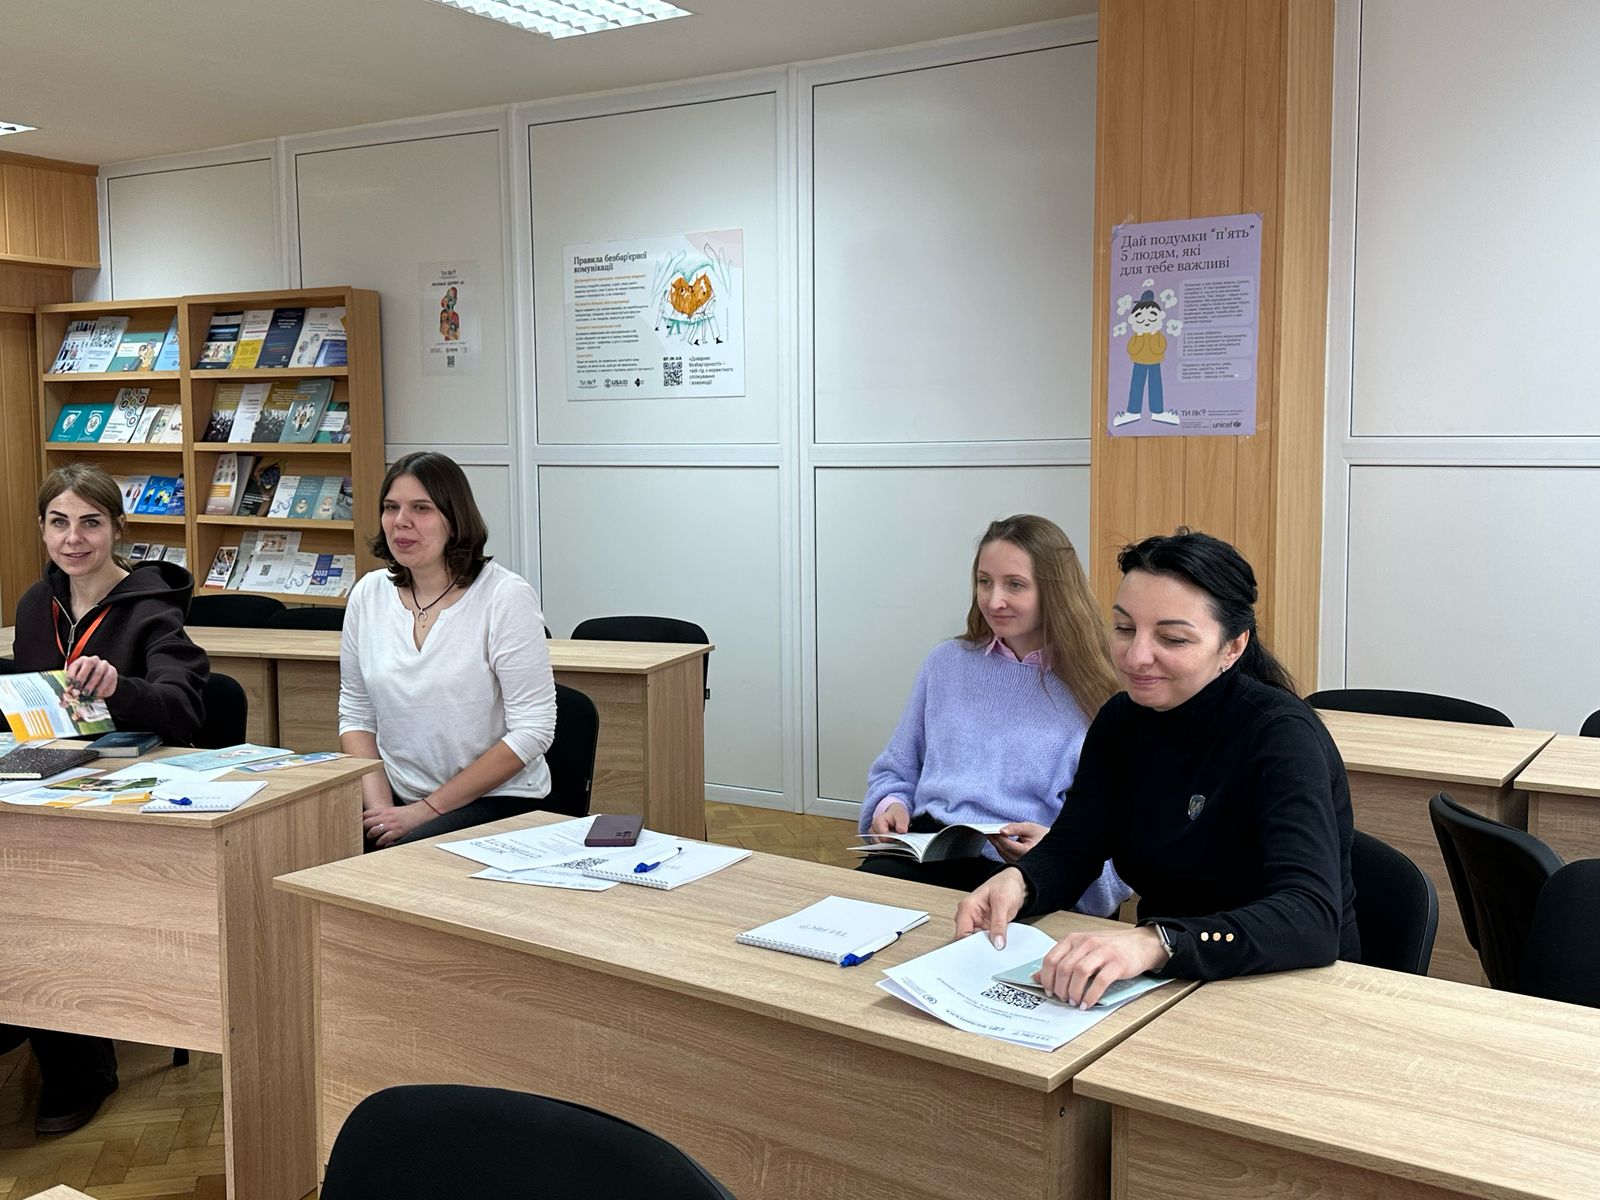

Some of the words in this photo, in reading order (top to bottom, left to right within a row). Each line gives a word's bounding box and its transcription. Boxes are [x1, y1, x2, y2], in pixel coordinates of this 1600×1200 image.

[1121, 234, 1147, 249] Дай
[1150, 231, 1207, 247] подумки
[574, 256, 603, 266] Правила
[1120, 249, 1128, 262] 5
[1131, 248, 1179, 261] людям,
[1182, 244, 1201, 257] які
[574, 263, 614, 274] комунікації
[1120, 265, 1142, 277] для
[1146, 260, 1174, 274] тебе
[1177, 256, 1230, 272] важливі
